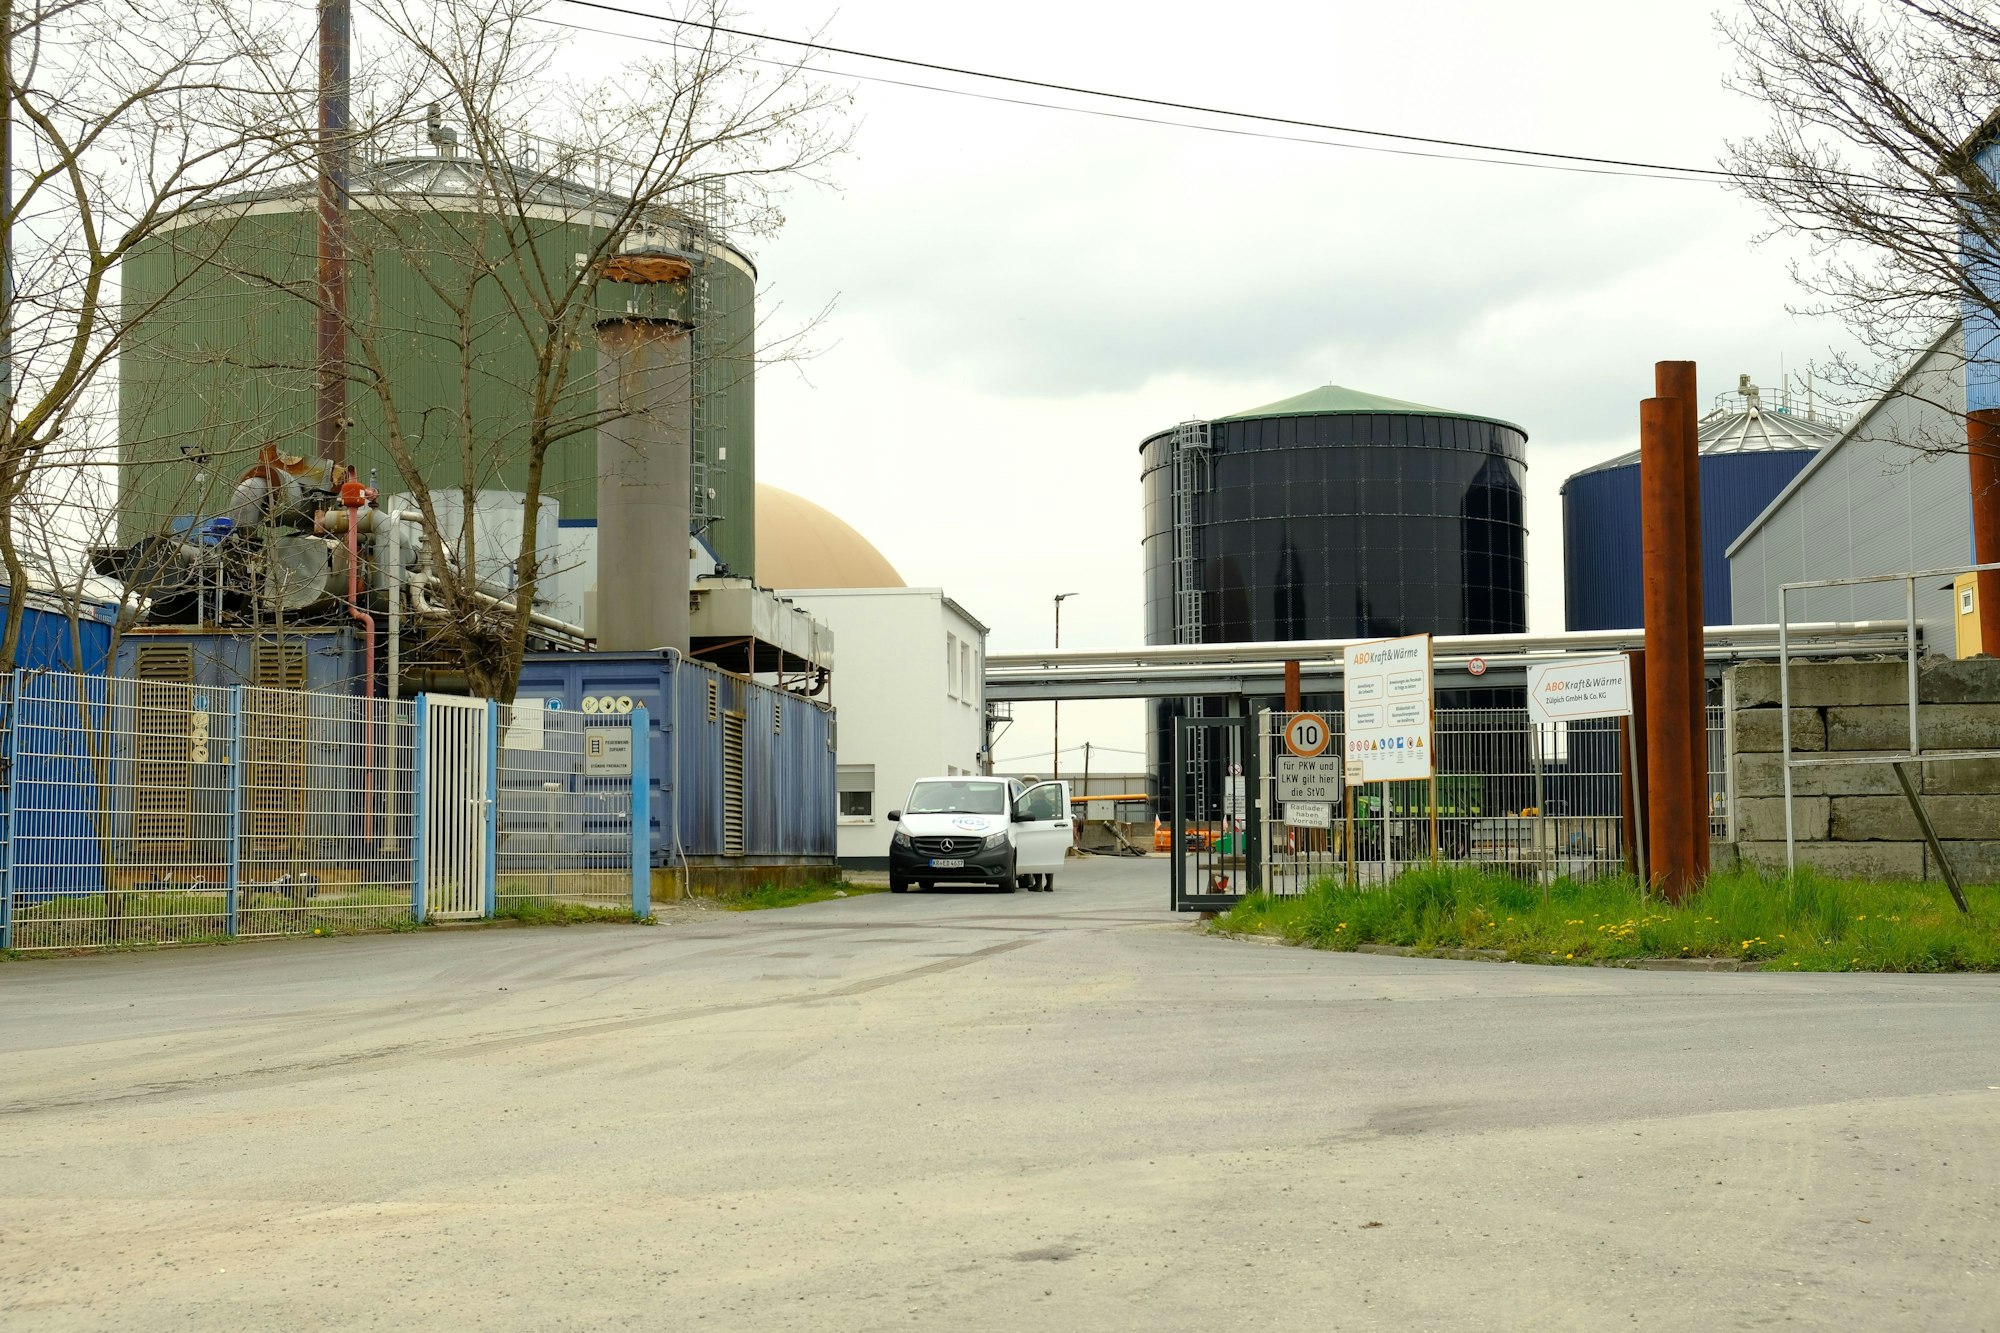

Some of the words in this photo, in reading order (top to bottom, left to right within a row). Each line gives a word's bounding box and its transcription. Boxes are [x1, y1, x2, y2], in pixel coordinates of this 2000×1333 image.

[1545, 694, 1565, 705] Zülpich
[1565, 693, 1582, 702] GmbH
[1583, 692, 1588, 700] &
[1589, 692, 1598, 700] Co.
[1297, 726, 1317, 745] 10
[1283, 761, 1295, 771] für
[1298, 761, 1316, 771] PKW
[1319, 761, 1334, 771] und
[1281, 775, 1298, 783] LKW
[1302, 775, 1315, 785] gilt
[1319, 775, 1335, 783] hier
[1291, 788, 1303, 797] die
[1307, 787, 1325, 797] StVO
[1290, 804, 1324, 812] Radlader
[1292, 818, 1323, 826] Vorrang
